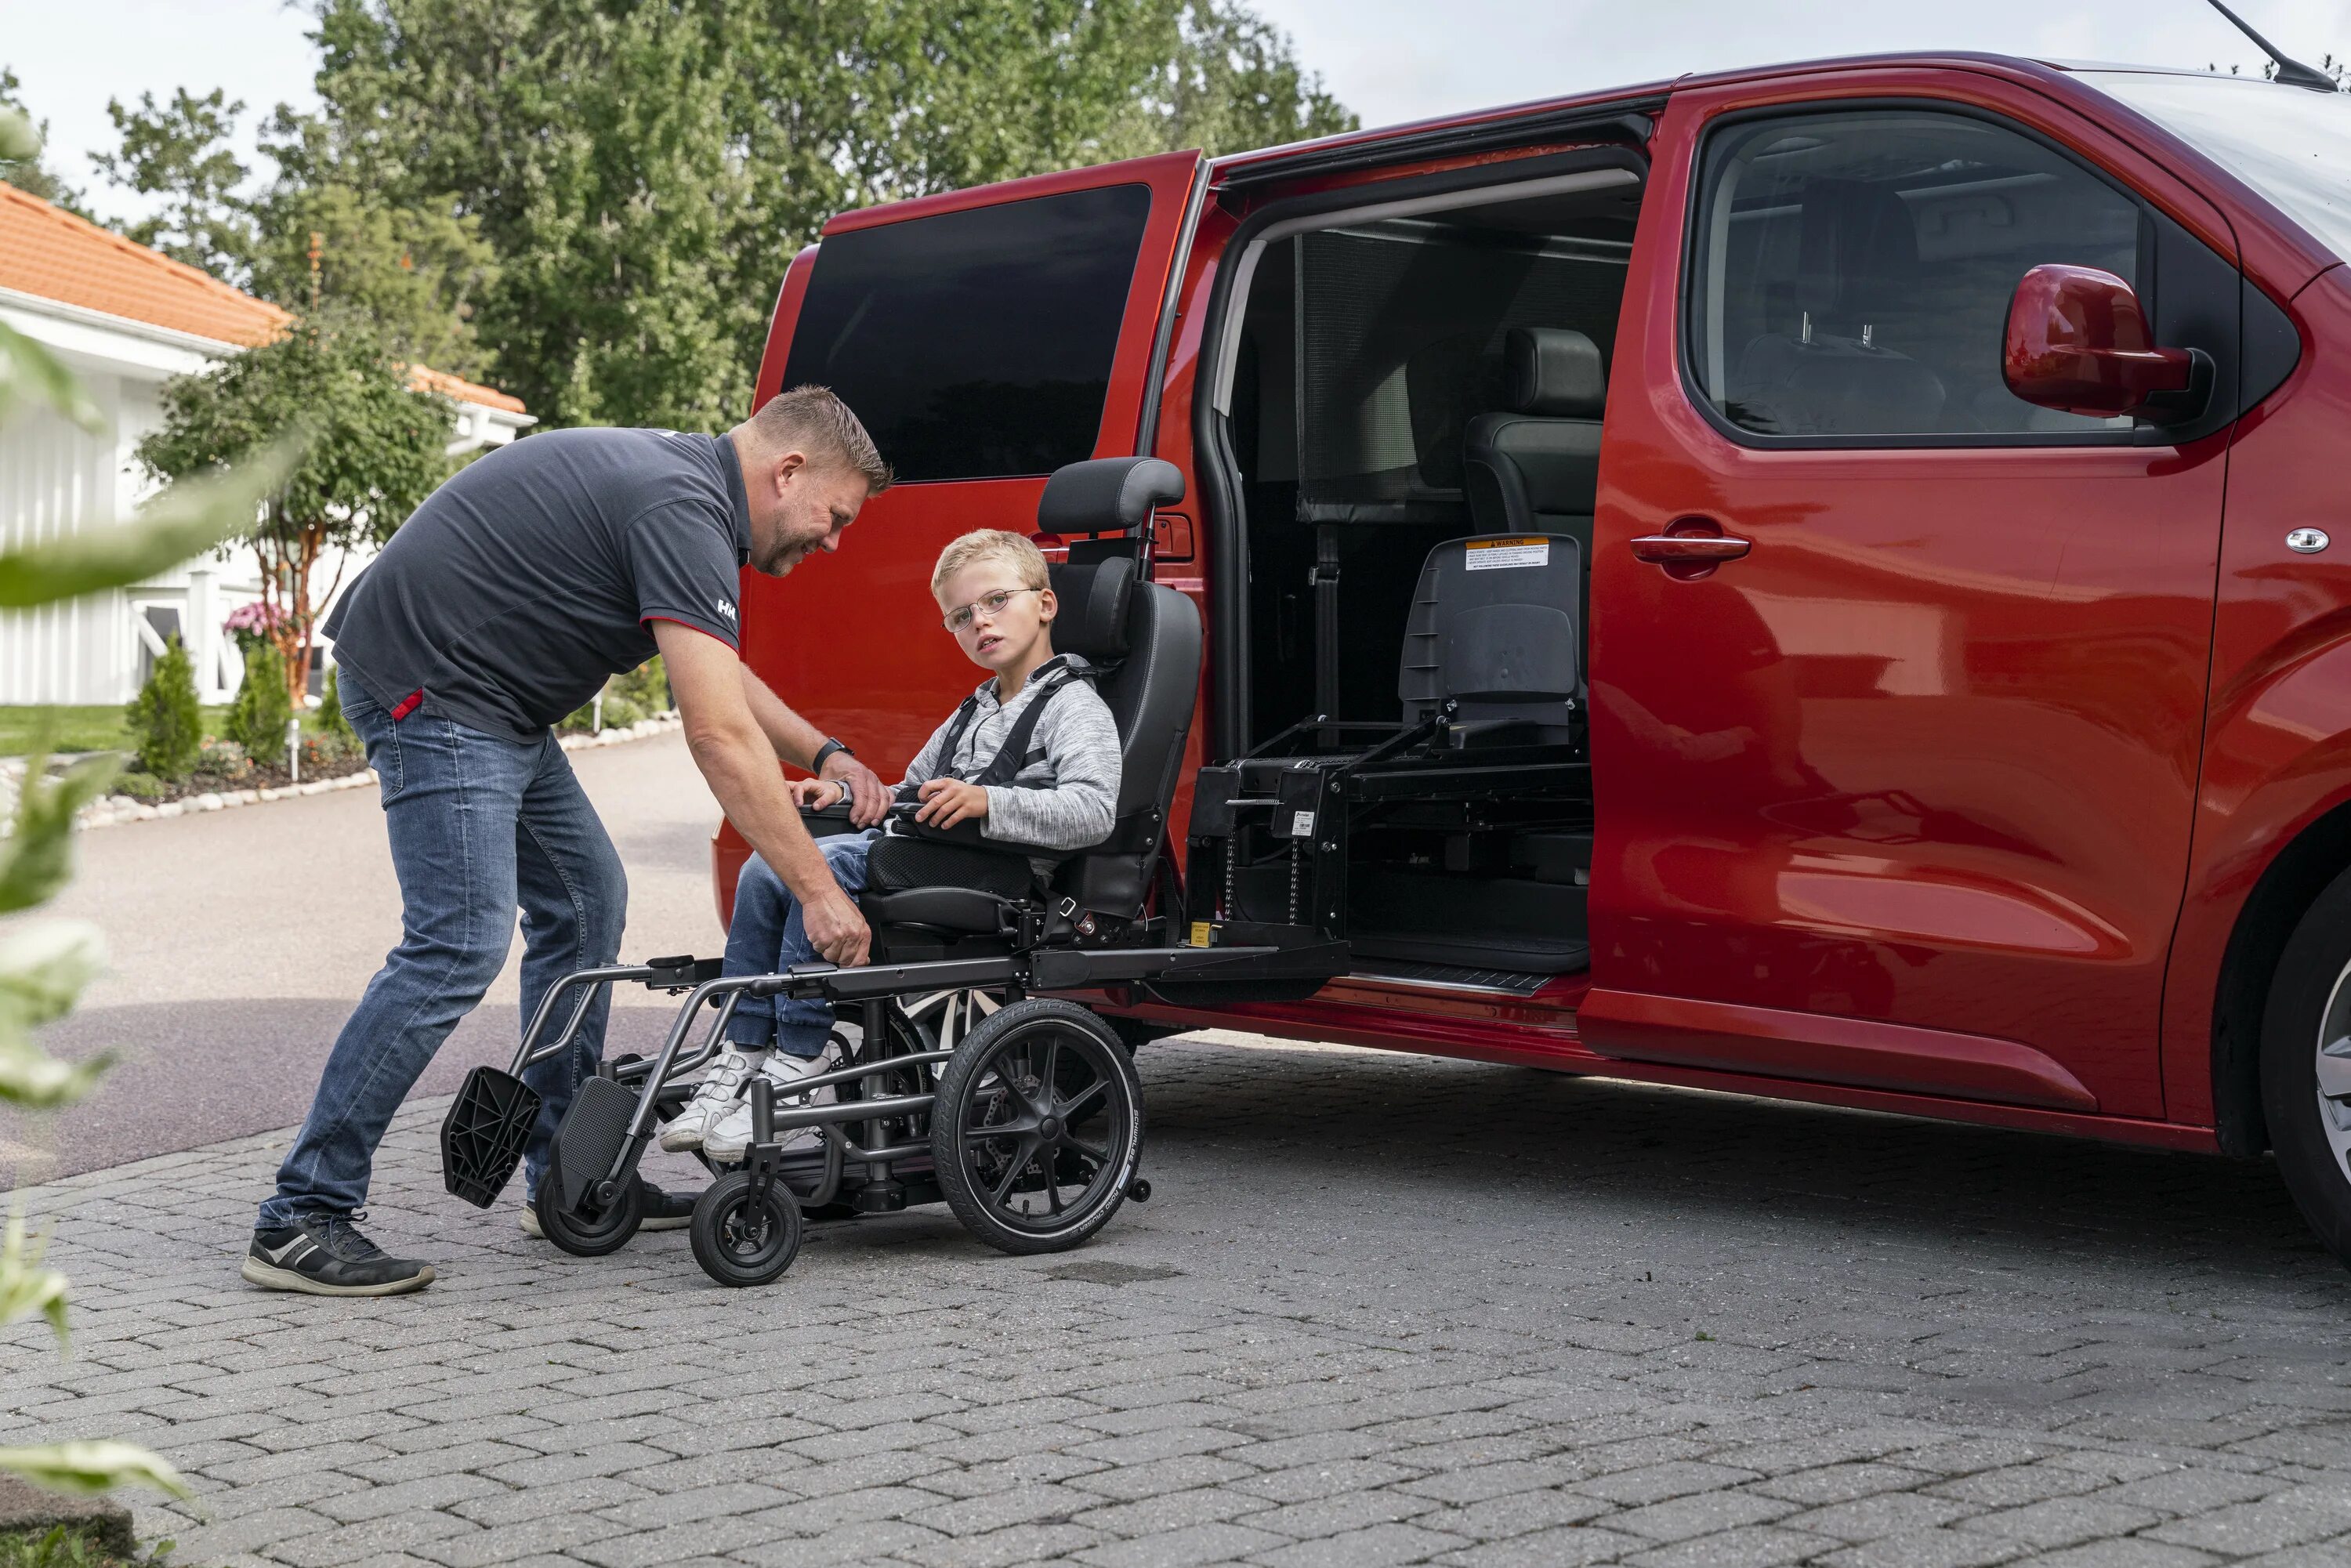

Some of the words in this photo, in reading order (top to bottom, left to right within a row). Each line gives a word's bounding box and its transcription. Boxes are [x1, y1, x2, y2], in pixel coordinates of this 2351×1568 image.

[717, 599, 736, 621] HH
[1128, 1109, 1139, 1162] SCHWALBE
[1105, 1190, 1119, 1210] ROAD
[1079, 1210, 1104, 1232] CRUISER
